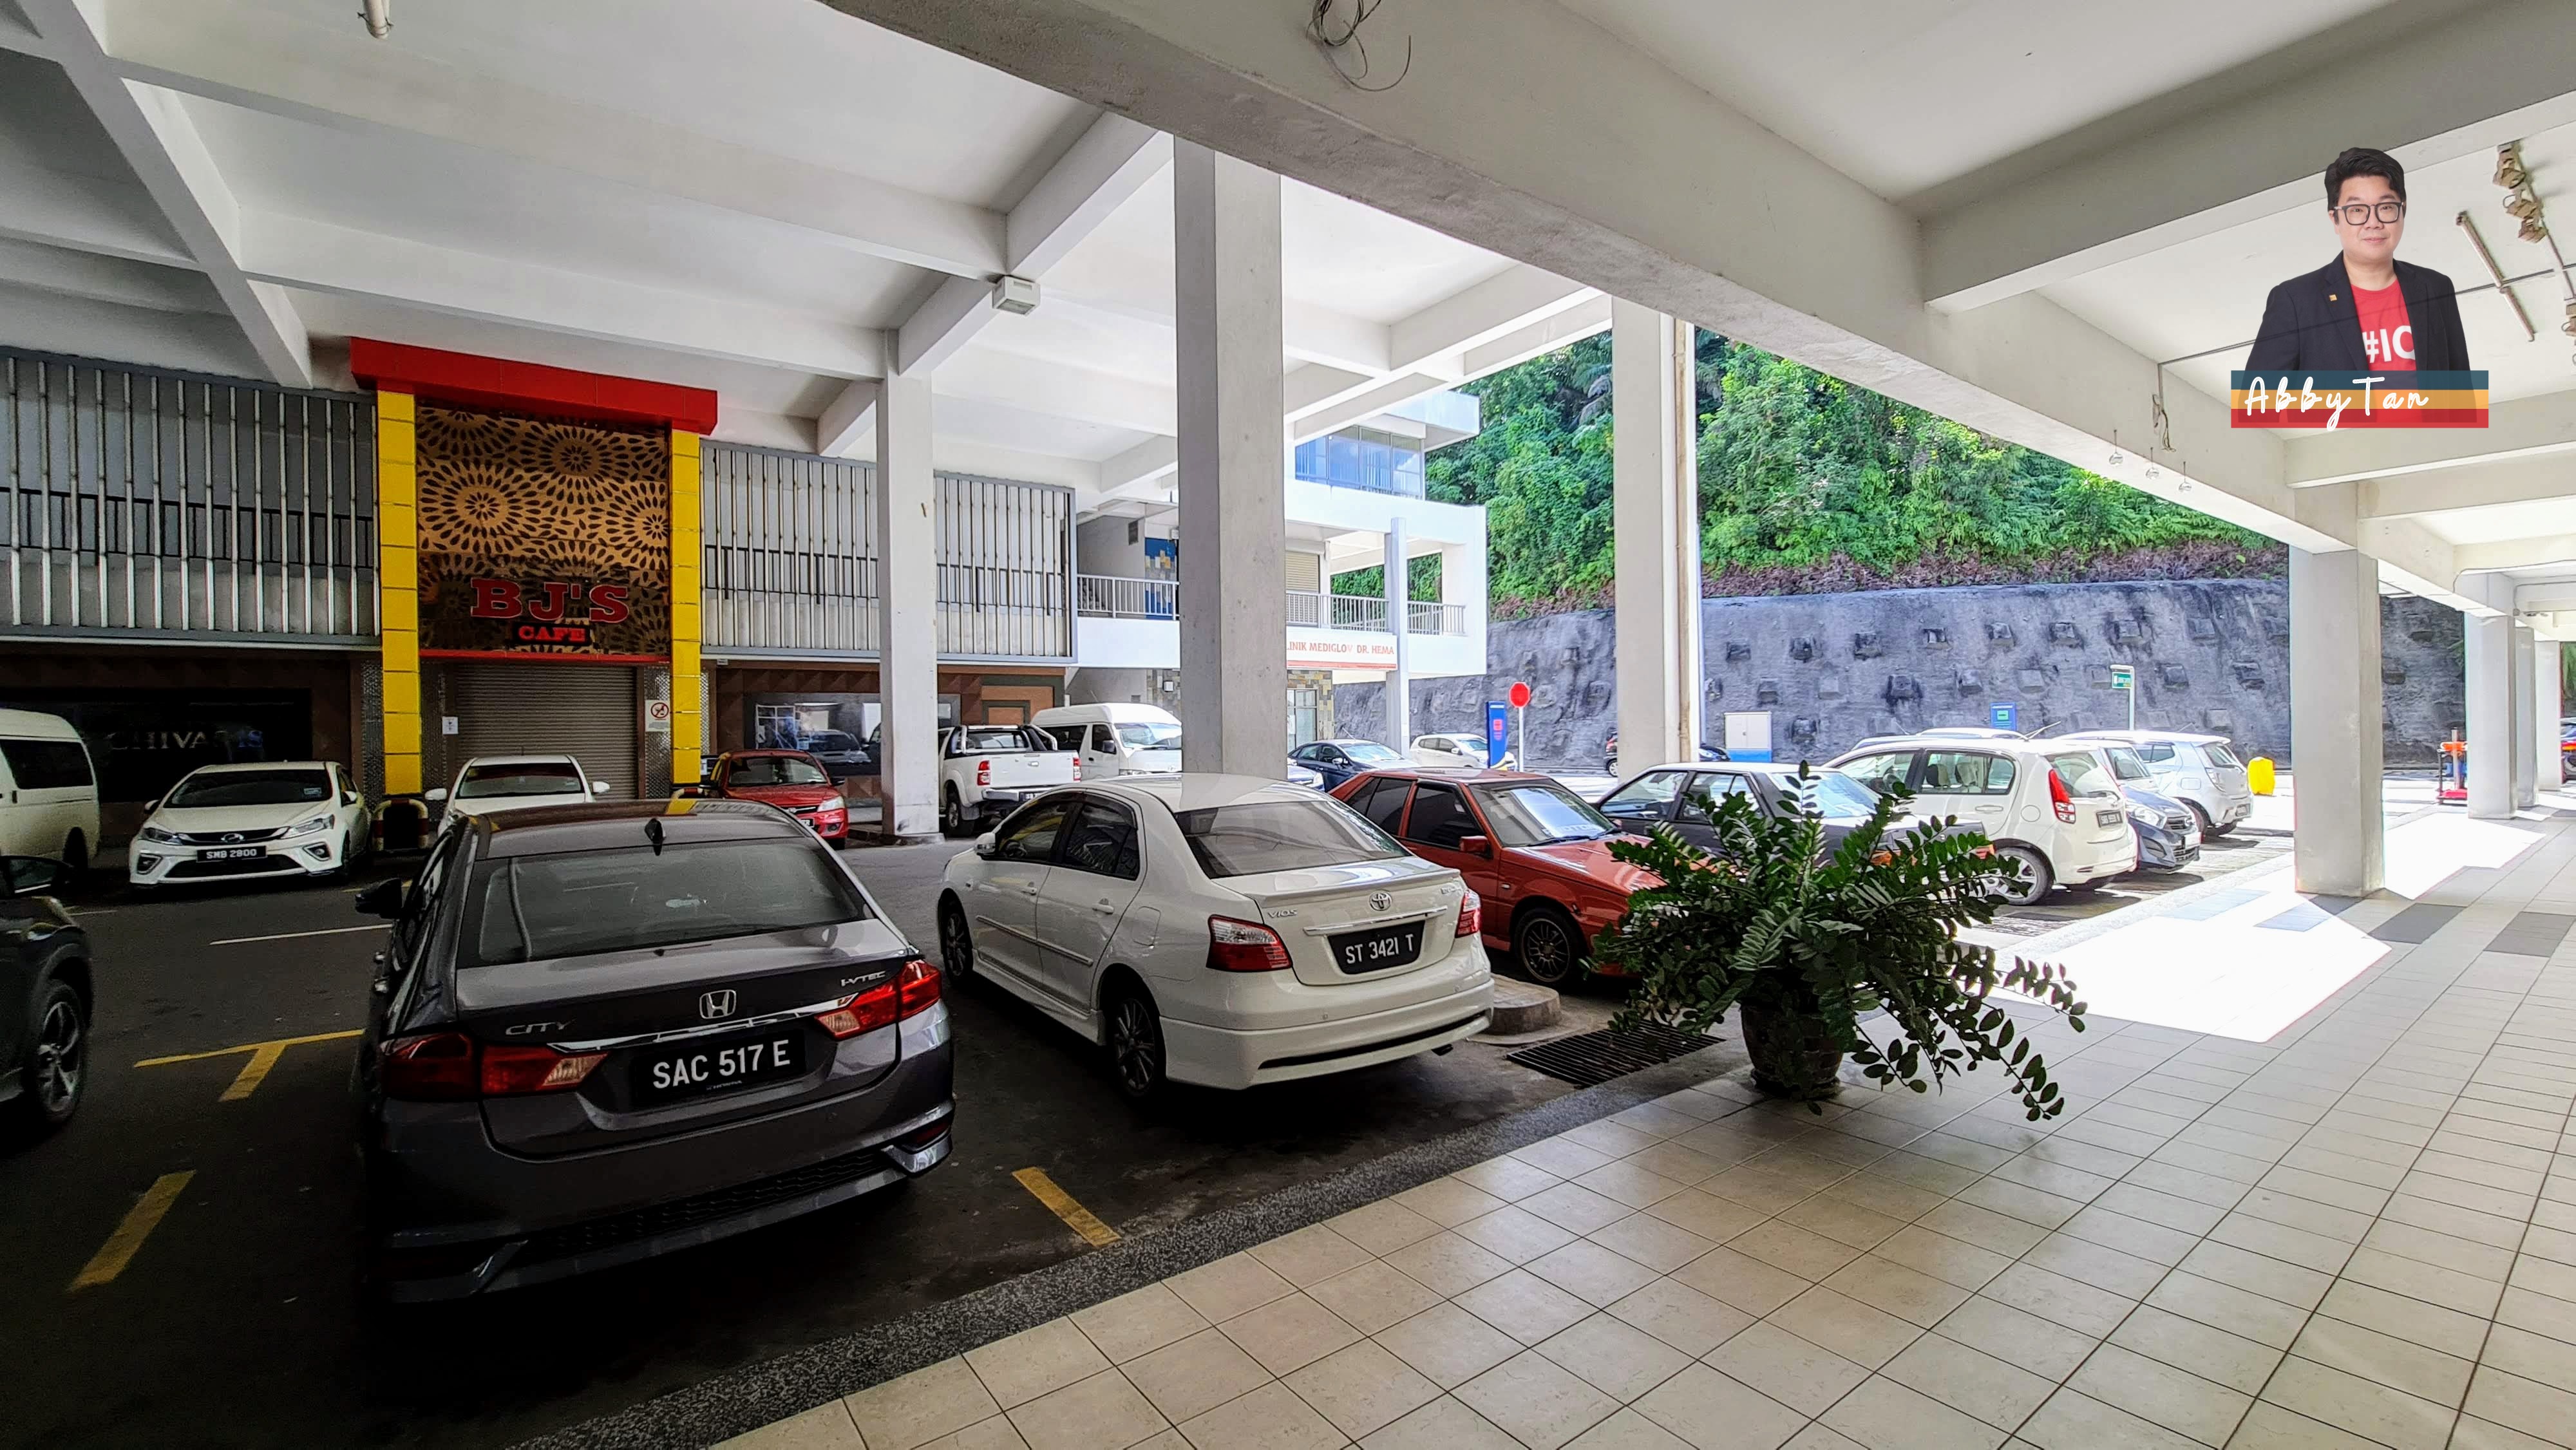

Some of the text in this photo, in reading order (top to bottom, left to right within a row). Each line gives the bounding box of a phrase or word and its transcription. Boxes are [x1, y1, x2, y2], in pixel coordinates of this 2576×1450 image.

[471, 578, 629, 623] BJ'S
[518, 625, 586, 642] CAFE
[1287, 641, 1307, 651] INIK
[1356, 645, 1369, 654] DR.
[1372, 645, 1394, 655] HEMA
[1267, 909, 1298, 918] VIOS
[1345, 934, 1414, 965] ST 3421 T
[505, 1019, 574, 1035] CITY
[653, 1039, 791, 1089] SAC 517 E
